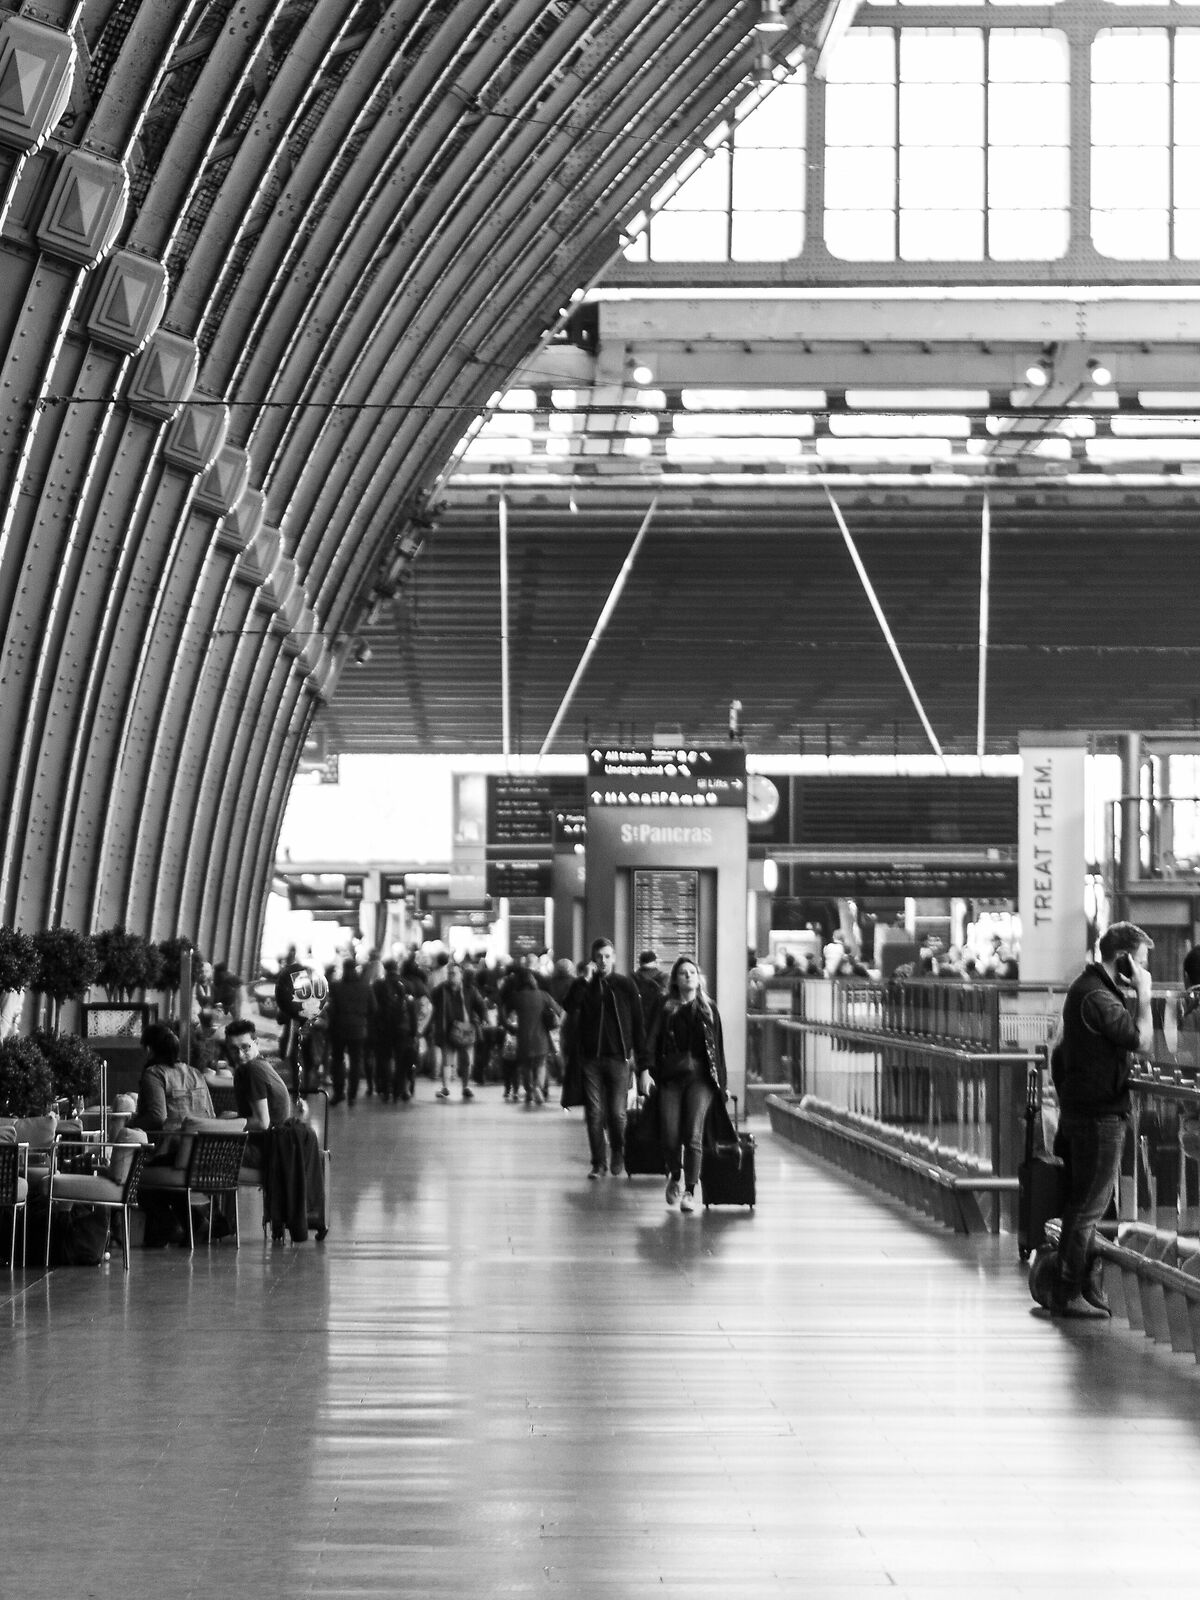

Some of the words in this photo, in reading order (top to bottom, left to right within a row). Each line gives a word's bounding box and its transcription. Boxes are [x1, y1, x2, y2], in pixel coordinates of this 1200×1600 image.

[605, 750, 619, 761] All
[620, 751, 647, 762] trains
[604, 764, 663, 776] Underground
[708, 778, 728, 789] Lifts
[1034, 757, 1052, 836] THEM.
[1034, 846, 1052, 927] TREAT
[291, 970, 327, 1000] 50
